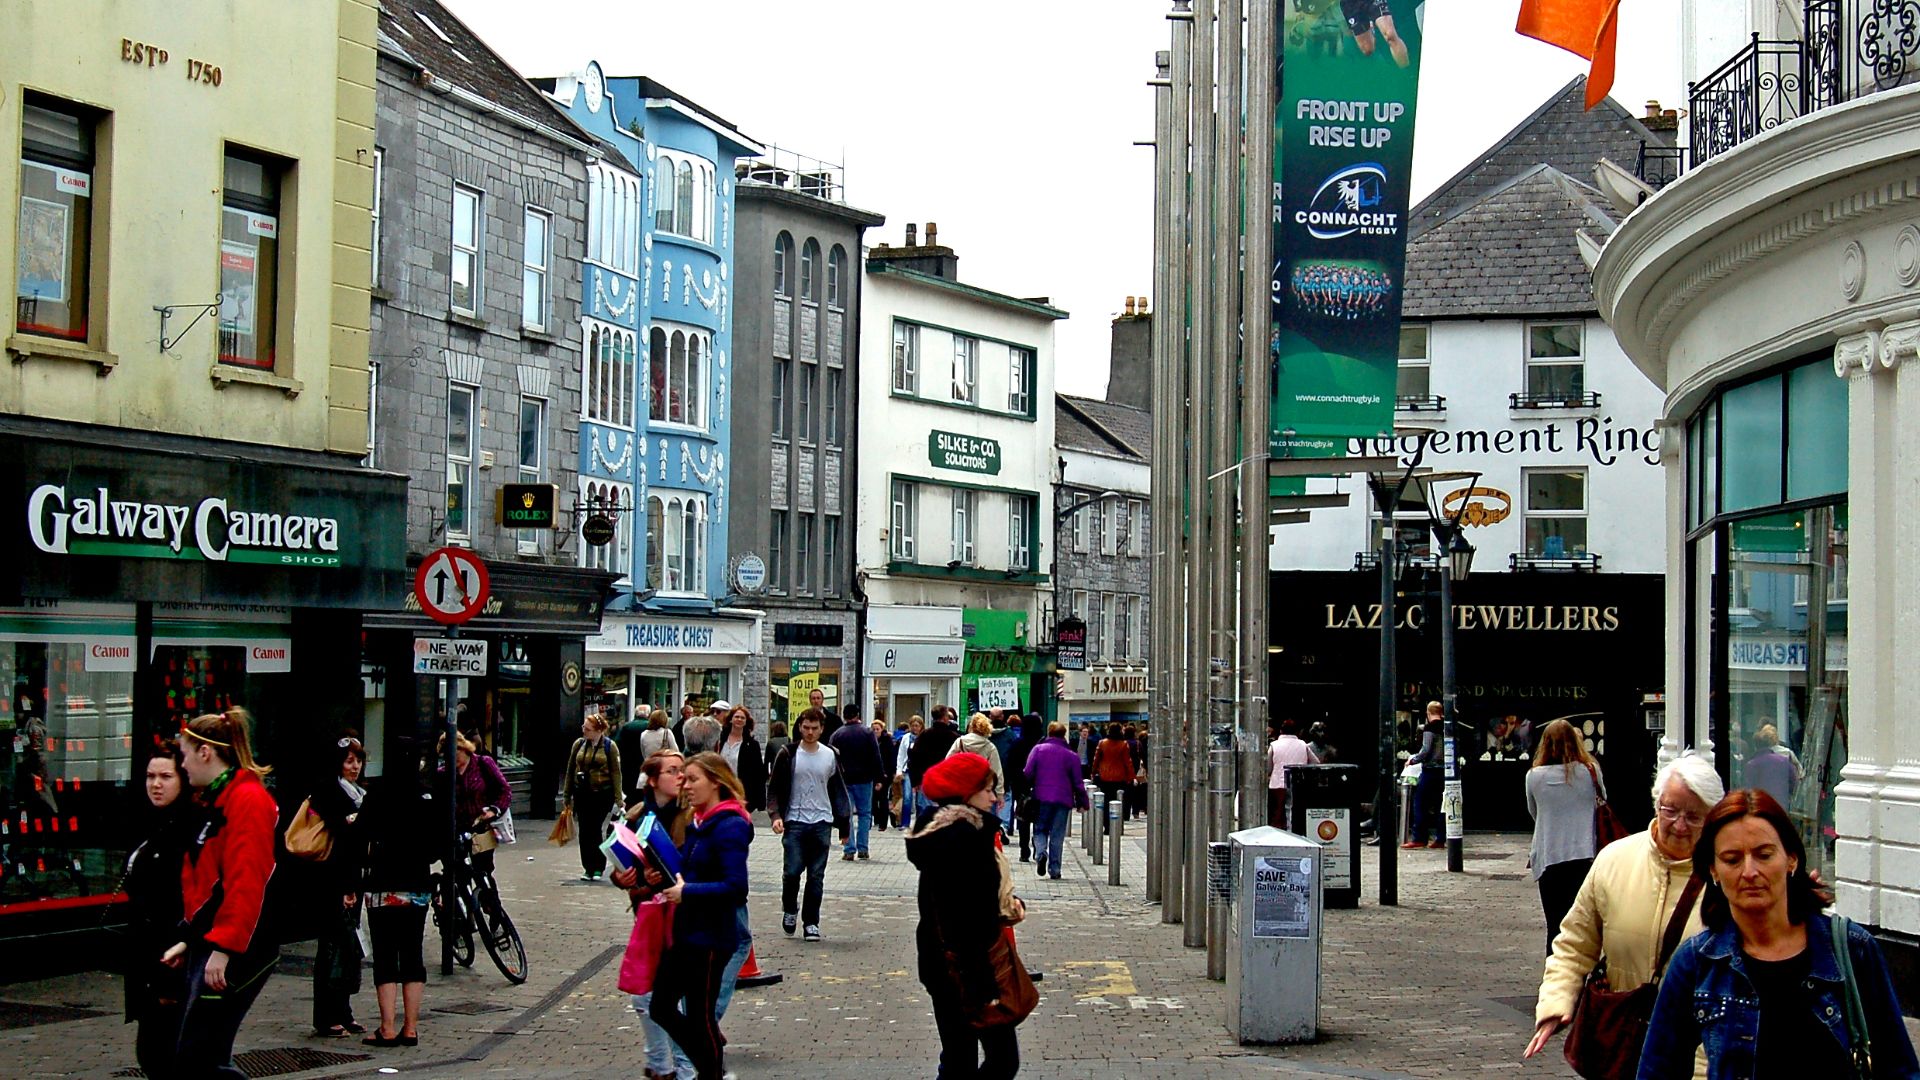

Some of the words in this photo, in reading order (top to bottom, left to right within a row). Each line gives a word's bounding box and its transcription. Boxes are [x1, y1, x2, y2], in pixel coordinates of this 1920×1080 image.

[187, 59, 222, 87] 1750
[1297, 100, 1369, 122] FRONT
[1374, 102, 1405, 122] UP
[1309, 126, 1355, 147] RISE
[1361, 128, 1391, 148] UP
[62, 175, 87, 189] Canon
[252, 218, 275, 231] Canon
[1295, 211, 1397, 226] CONNACHT
[1361, 227, 1398, 235] RUGBY
[1296, 394, 1380, 404] www.connachtrugby.ie
[937, 433, 968, 453] SILKE
[970, 439, 979, 454] &
[980, 440, 996, 458] CO.
[945, 452, 987, 469] SOLICITORS
[507, 510, 549, 520] ROLEX
[28, 484, 190, 553] Galway
[194, 497, 339, 561] Camera
[281, 555, 338, 564] SHOP
[482, 596, 502, 614] Son
[625, 625, 678, 648] TREASURE
[682, 626, 713, 648] CHEST
[92, 644, 129, 658] Canon
[252, 647, 285, 659] Canon
[455, 644, 484, 656] WAY
[421, 658, 480, 672] TRAFFIC
[1302, 655, 1315, 664] 20
[794, 680, 803, 689] TO
[805, 680, 814, 689] LET
[1256, 871, 1286, 882] SAVE
[1256, 883, 1287, 893] Galway
[1289, 884, 1305, 893] Bay
